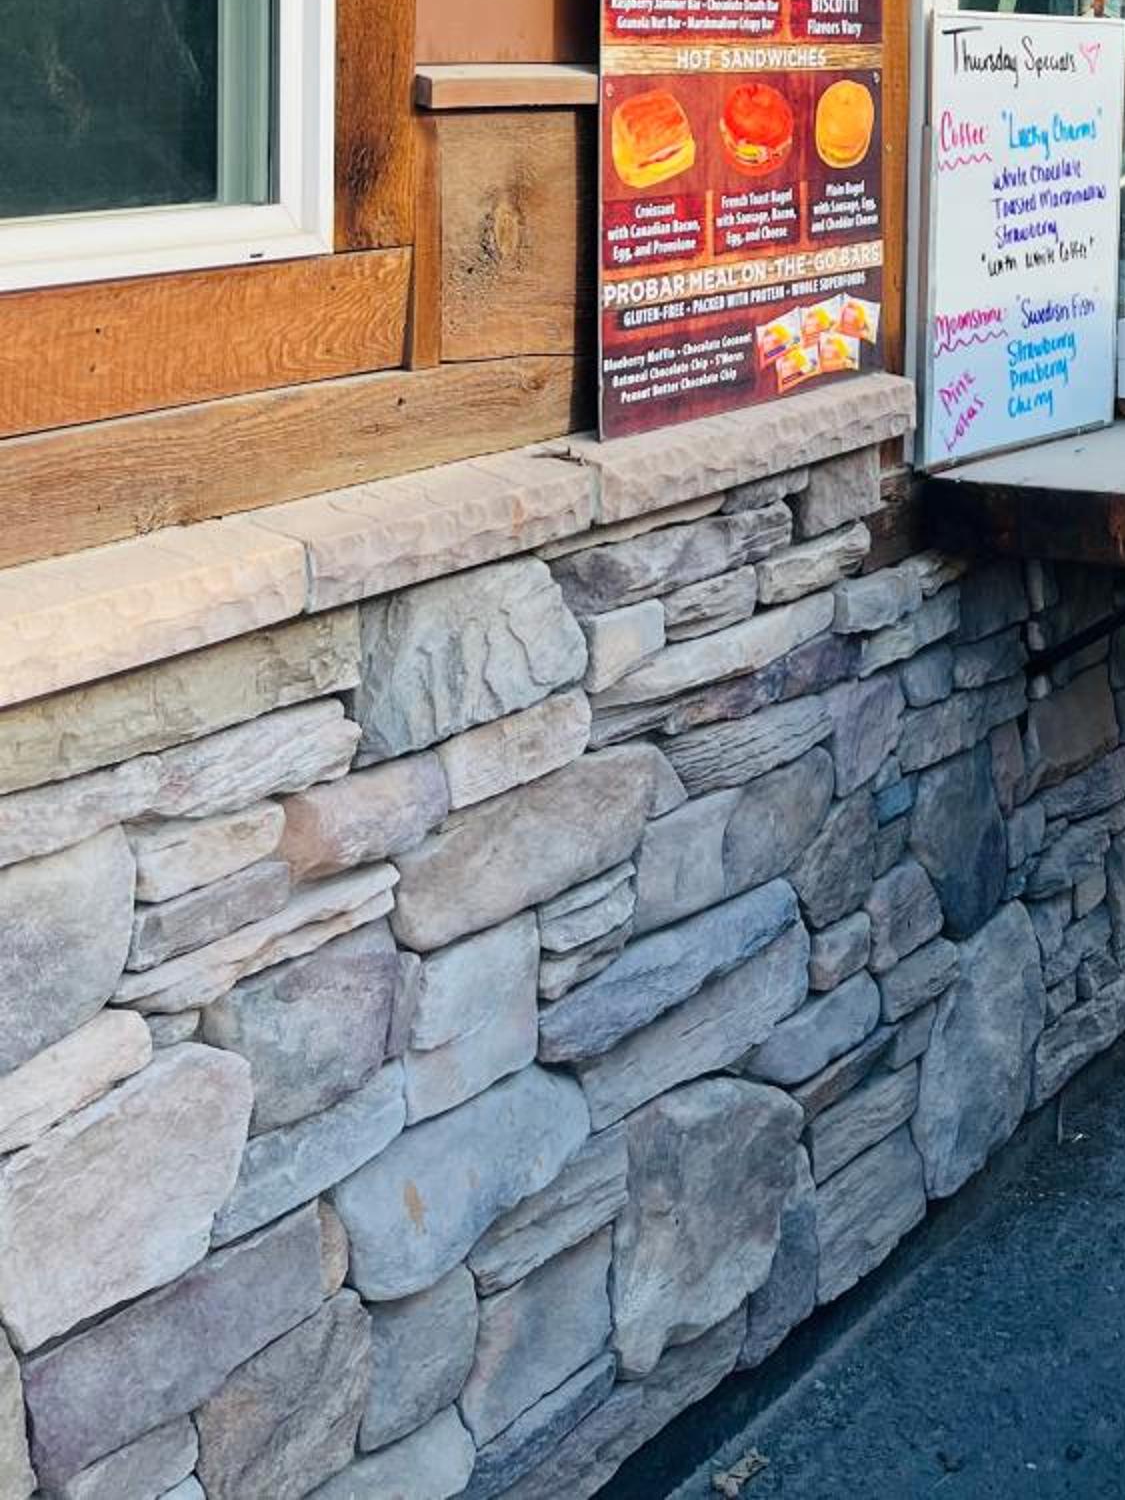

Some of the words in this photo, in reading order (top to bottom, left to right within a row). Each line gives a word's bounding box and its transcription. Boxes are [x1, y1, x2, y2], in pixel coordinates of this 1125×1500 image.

[807, 20, 839, 35] Flavors
[842, 21, 862, 38] Vary
[677, 50, 712, 70] HOT
[720, 49, 827, 69] SANDWICHES
[942, 26, 1019, 89] Thursday
[1021, 35, 1077, 78] Specials
[721, 194, 748, 209] French
[749, 192, 769, 205] Toast
[771, 188, 793, 205] Bagel
[826, 183, 844, 197] Plain
[845, 180, 865, 197] Bagel
[635, 202, 675, 219] Croissant
[716, 215, 734, 227] with
[771, 207, 797, 220] Bacon,
[813, 202, 830, 215] with
[992, 193, 1037, 220] Toasted
[607, 225, 629, 241] with
[630, 221, 671, 238] Canadian
[745, 227, 761, 242] and
[761, 225, 788, 239] Cheese
[811, 219, 825, 233] and
[825, 217, 854, 230] Cheddar
[855, 214, 878, 227] Cheese
[634, 241, 652, 257] and
[603, 274, 685, 308] PROBAR
[689, 266, 737, 292] MEAL
[840, 241, 880, 266] BARS
[623, 301, 685, 327] GLUTEN-FREE
[692, 295, 724, 314] PACKED
[727, 290, 749, 308] WITH
[750, 285, 785, 303] PROTEIN
[792, 279, 819, 296] WHOLE
[603, 354, 645, 372] Blueberry
[647, 348, 675, 363] Muffin
[682, 339, 721, 355] Chocolate
[721, 332, 753, 348] Coconut
[1007, 331, 1077, 367] Strawberry
[612, 371, 649, 388] Oatmeal
[649, 361, 689, 380] Chocolate
[690, 357, 708, 372] Chip
[620, 387, 650, 404] Peanut
[651, 382, 679, 397] Butter
[680, 373, 719, 389] Chocolate
[719, 367, 738, 381] Chip
[1007, 388, 1053, 418] Cherry
